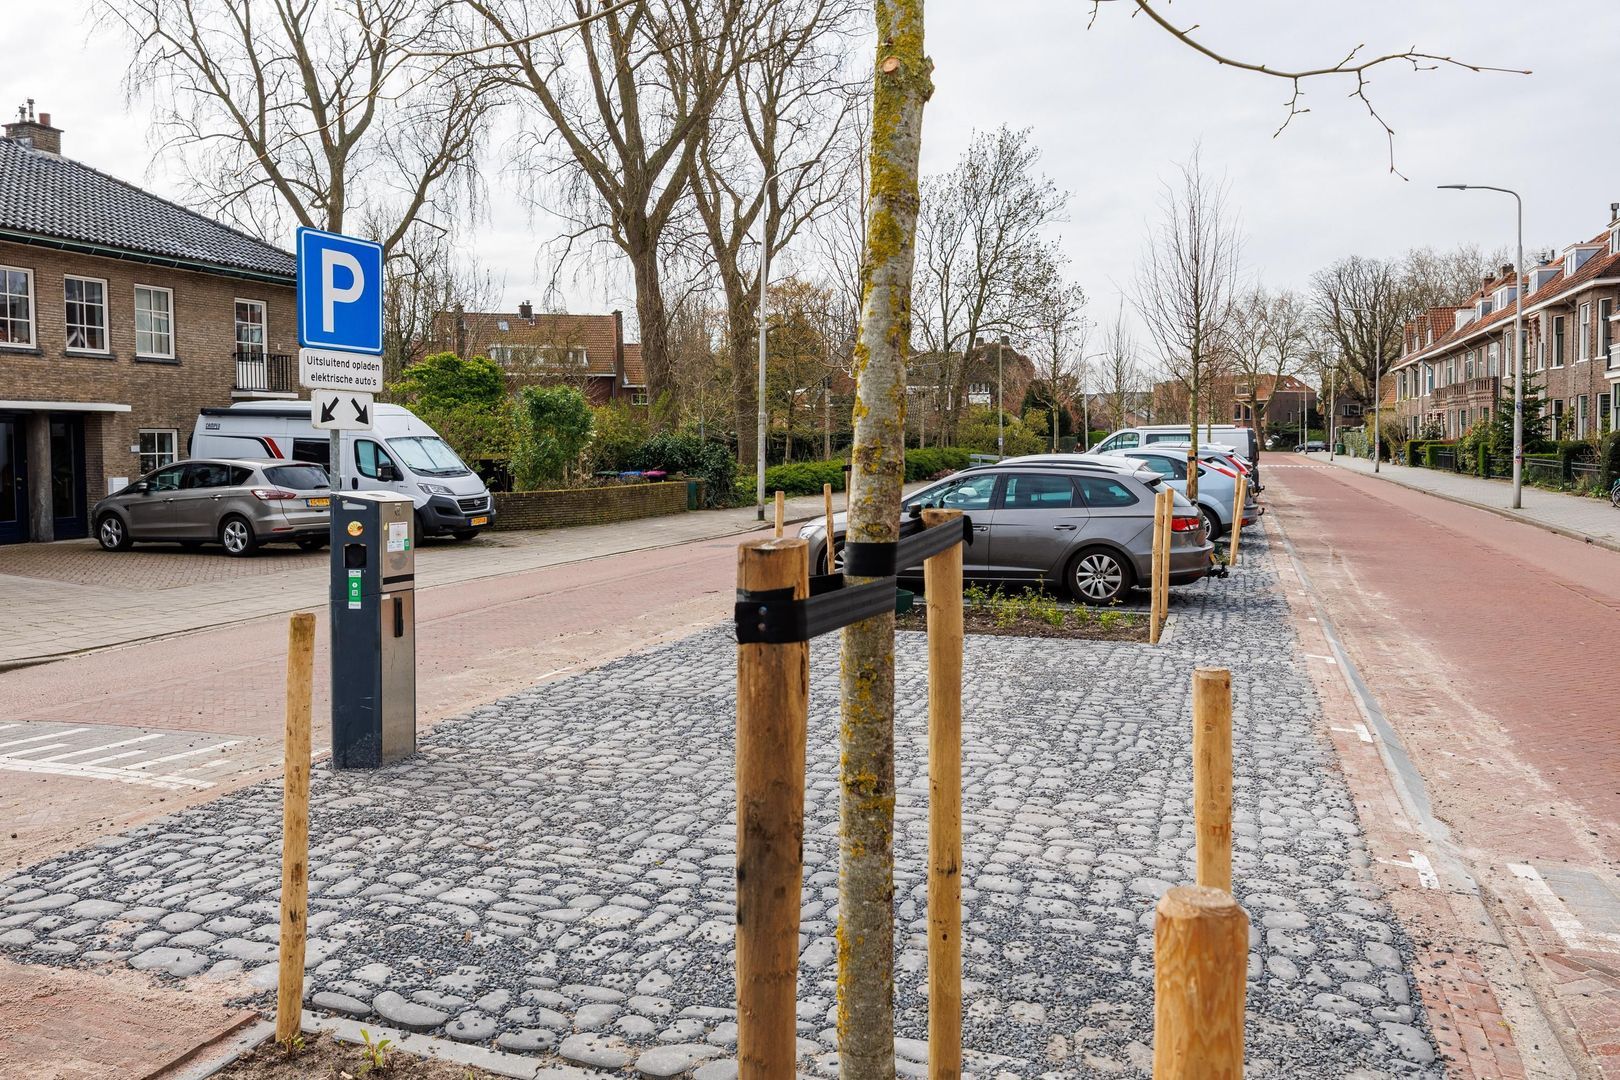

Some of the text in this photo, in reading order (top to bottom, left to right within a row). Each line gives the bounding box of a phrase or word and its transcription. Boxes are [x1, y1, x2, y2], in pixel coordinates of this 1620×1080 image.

[321, 248, 365, 333] P
[306, 355, 380, 372] Uitsluitend opladen
[310, 372, 377, 386] elektrische auto's
